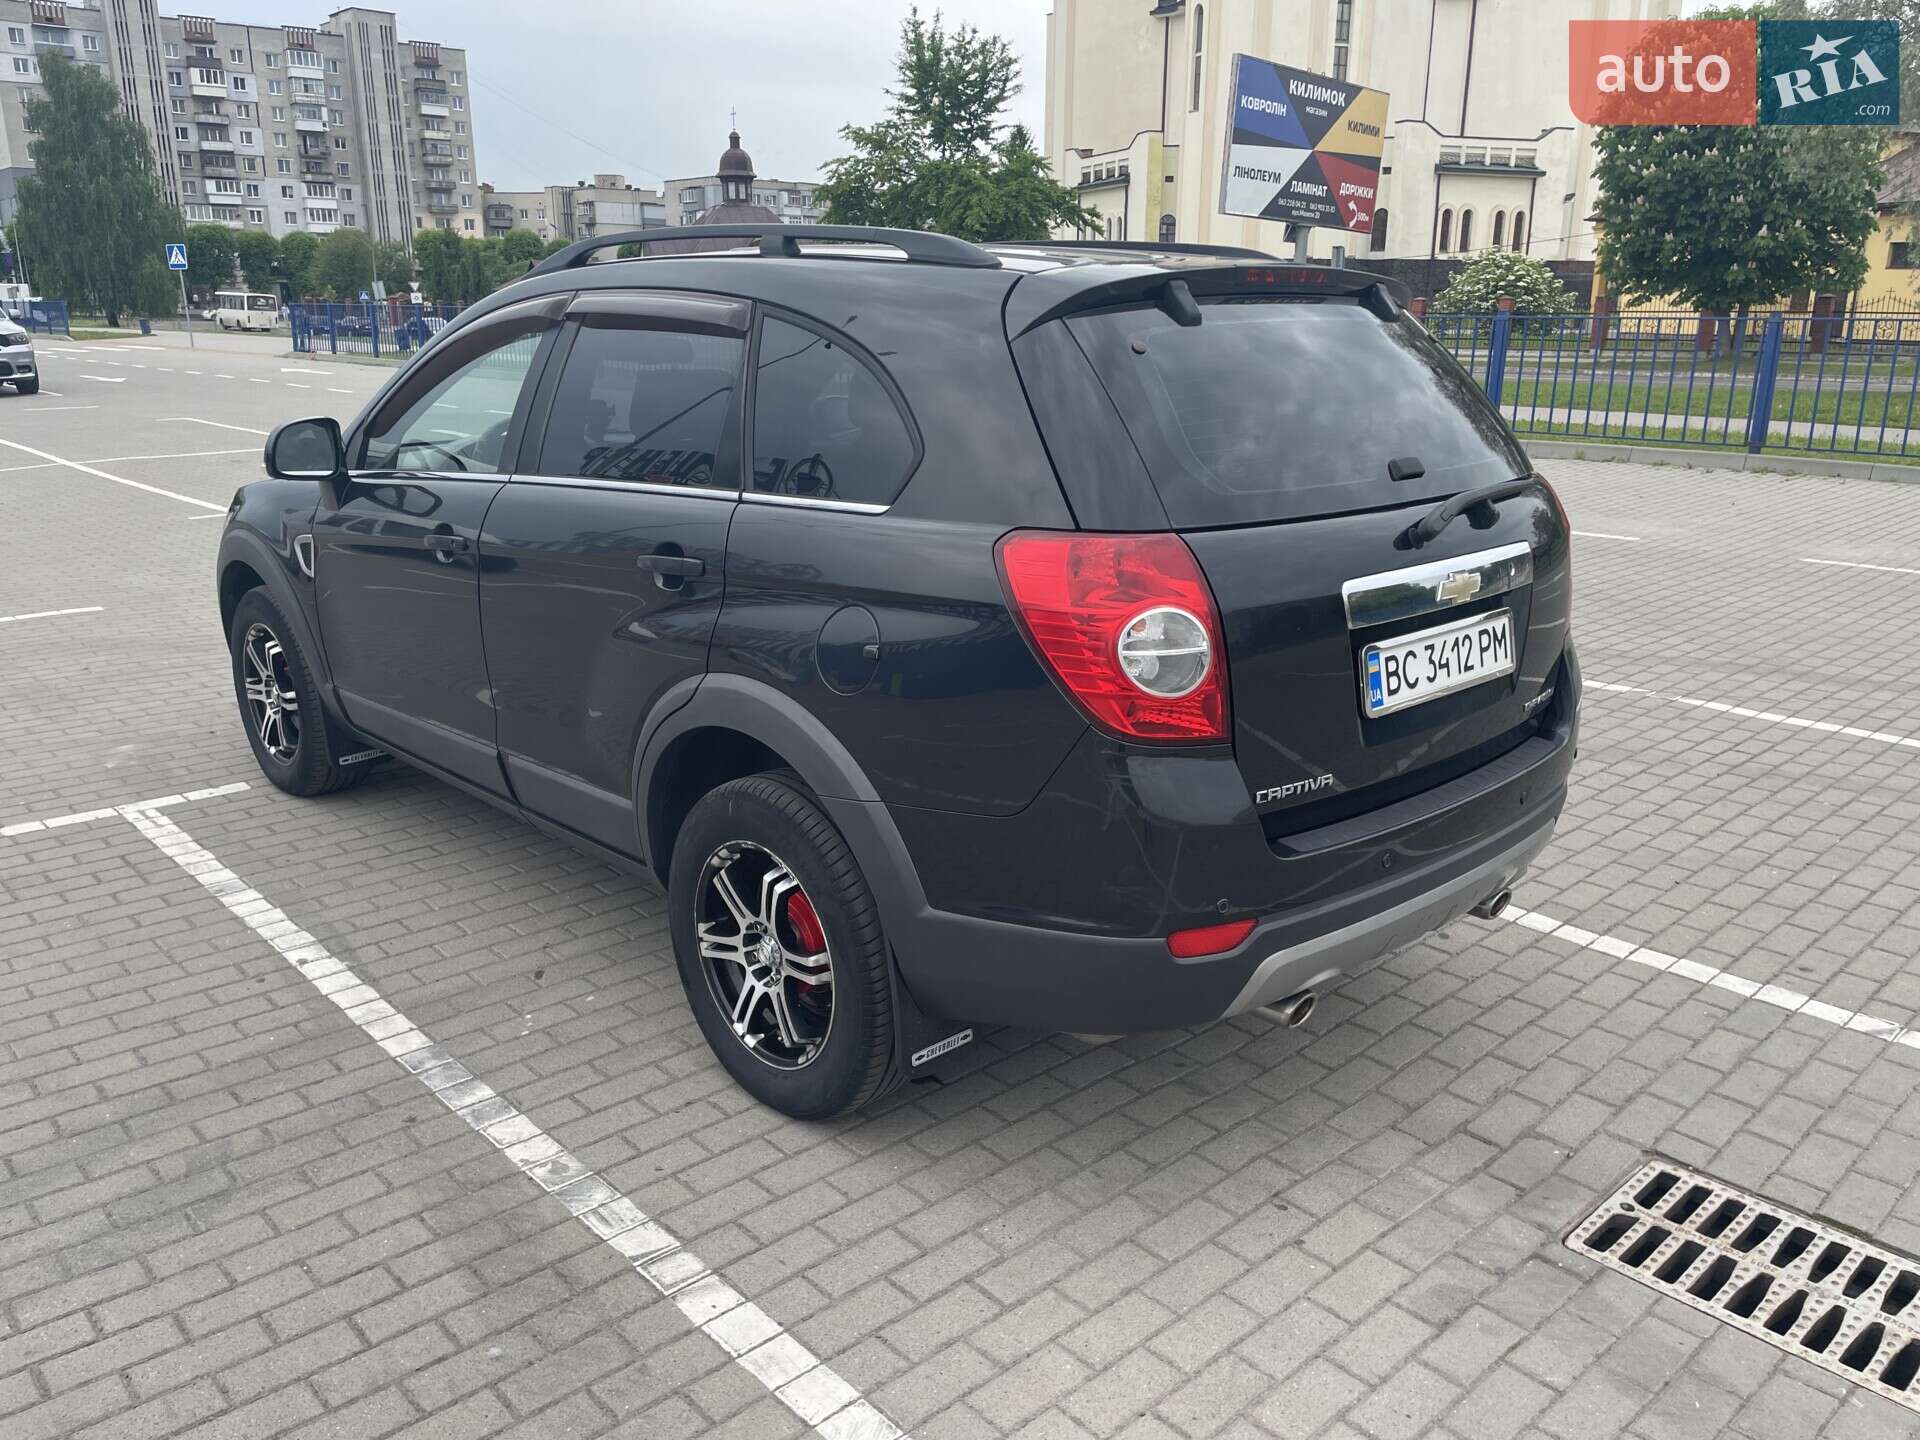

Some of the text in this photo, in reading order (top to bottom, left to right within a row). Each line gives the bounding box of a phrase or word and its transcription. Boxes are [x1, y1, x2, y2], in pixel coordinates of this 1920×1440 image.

[1289, 79, 1346, 107] КИЛИМОК
[1240, 95, 1287, 117] КОВРОЛІН
[1305, 105, 1328, 117] магазин
[1347, 119, 1380, 138] КИЛИМИ
[1233, 165, 1281, 184] ЛІНОЛЕУМ
[1290, 180, 1328, 197] ЛАМІНАТ
[1339, 182, 1374, 199] ДОРІЖКИ
[1385, 622, 1508, 697] BC 3412 PM
[1370, 689, 1382, 702] UA
[1256, 773, 1334, 804] CAPTIVA
